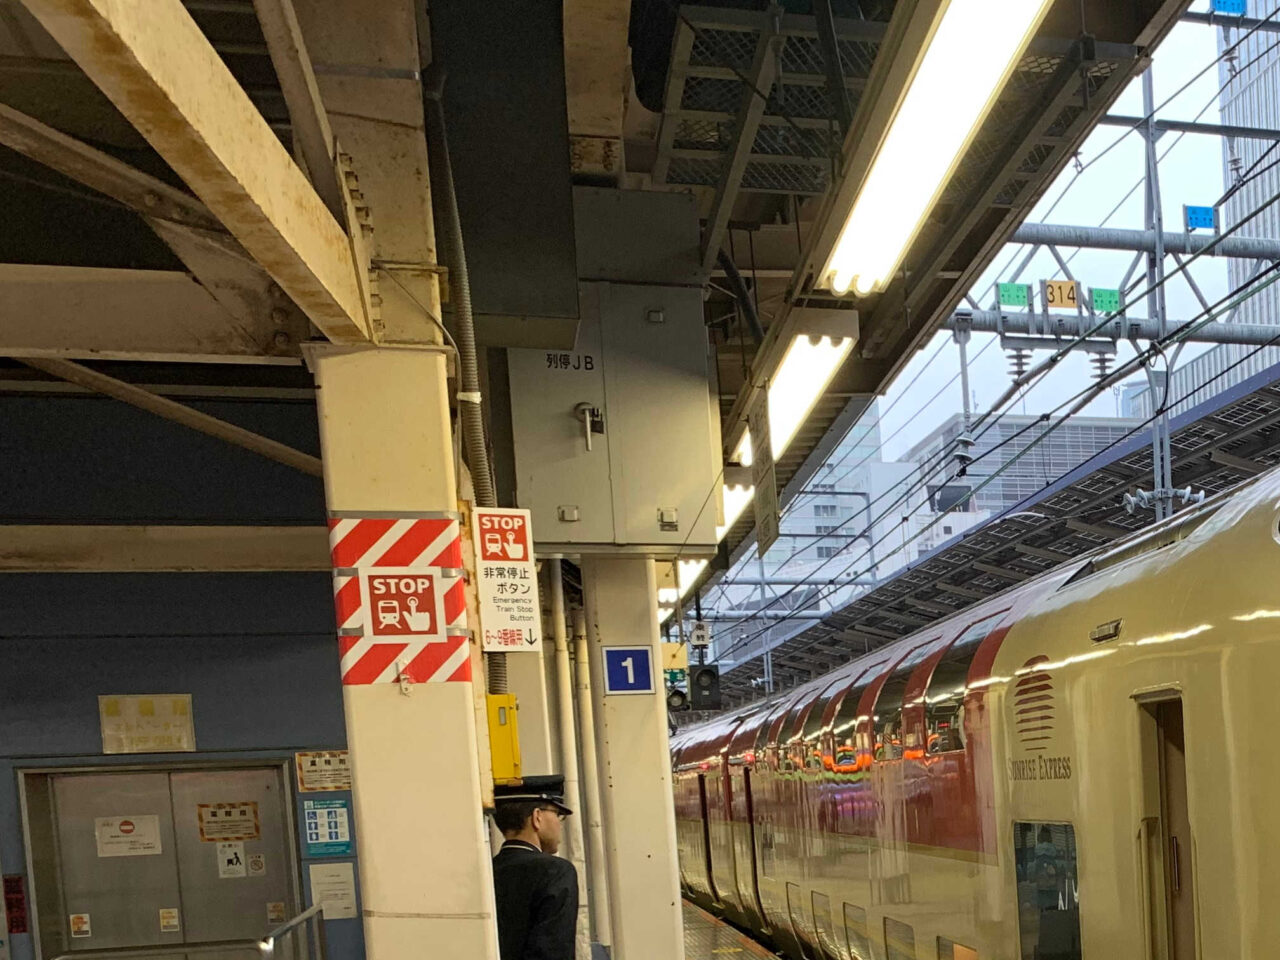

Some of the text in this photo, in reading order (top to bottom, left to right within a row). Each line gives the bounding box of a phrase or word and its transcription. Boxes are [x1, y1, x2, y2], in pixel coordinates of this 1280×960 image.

[1046, 284, 1076, 304] 314
[546, 353, 594, 371] 列停JB
[481, 516, 523, 530] STOP
[484, 566, 530, 579] 非常停止
[373, 578, 430, 594] STOP
[497, 583, 531, 594] ボタン
[493, 596, 532, 605] Emergency
[496, 605, 534, 614] Train Stop
[510, 614, 534, 622] Button
[621, 657, 635, 684] 1
[1008, 755, 1072, 781] SUNRISE EXPRESS
